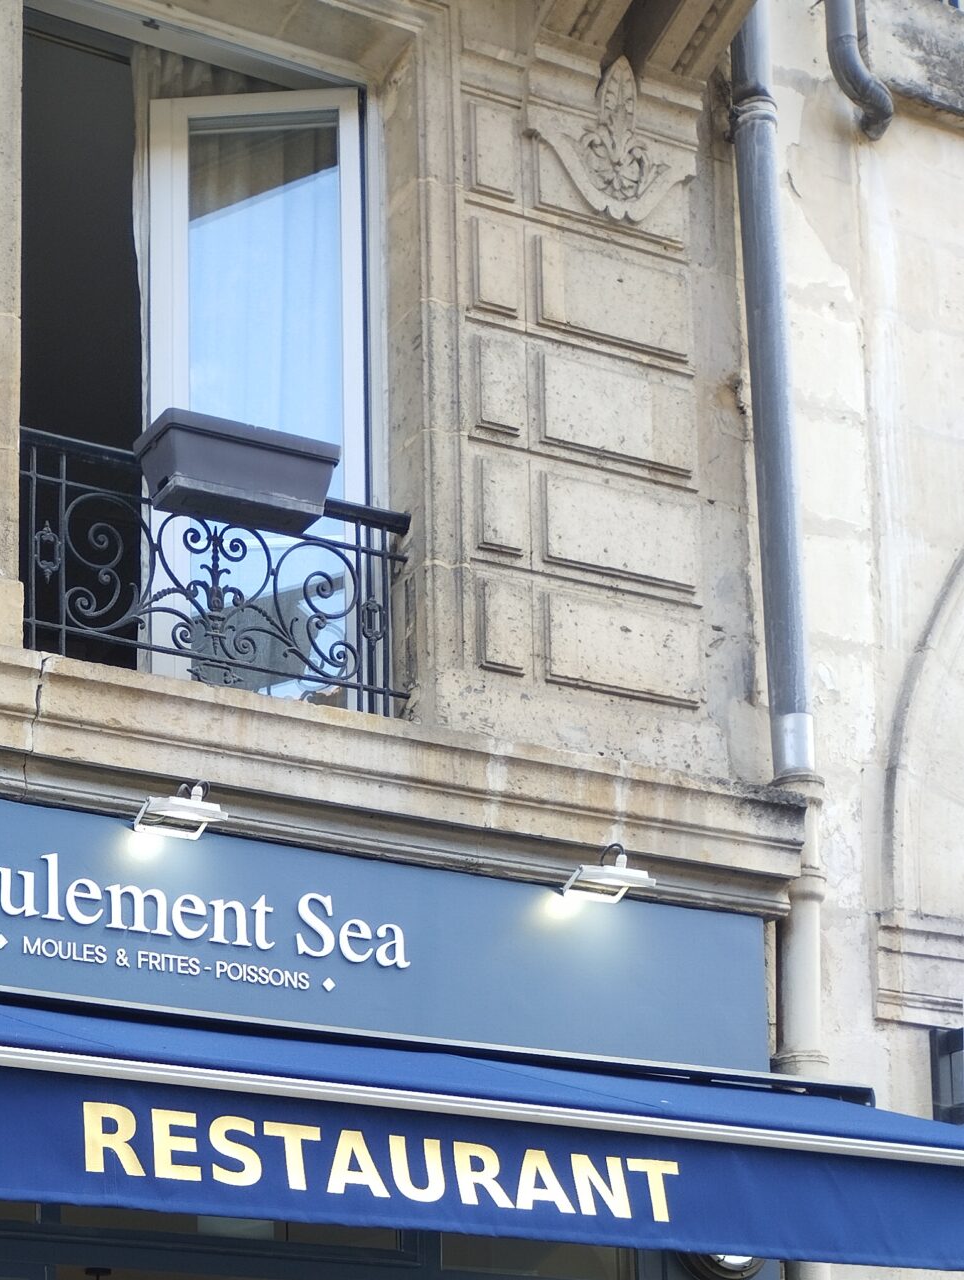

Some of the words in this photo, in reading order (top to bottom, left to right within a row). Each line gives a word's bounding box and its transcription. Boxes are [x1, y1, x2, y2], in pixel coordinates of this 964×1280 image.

[23, 937, 108, 965] MOULES
[116, 950, 129, 968] &
[296, 893, 411, 969] Sea
[82, 1101, 680, 1223] RESTAURANT
